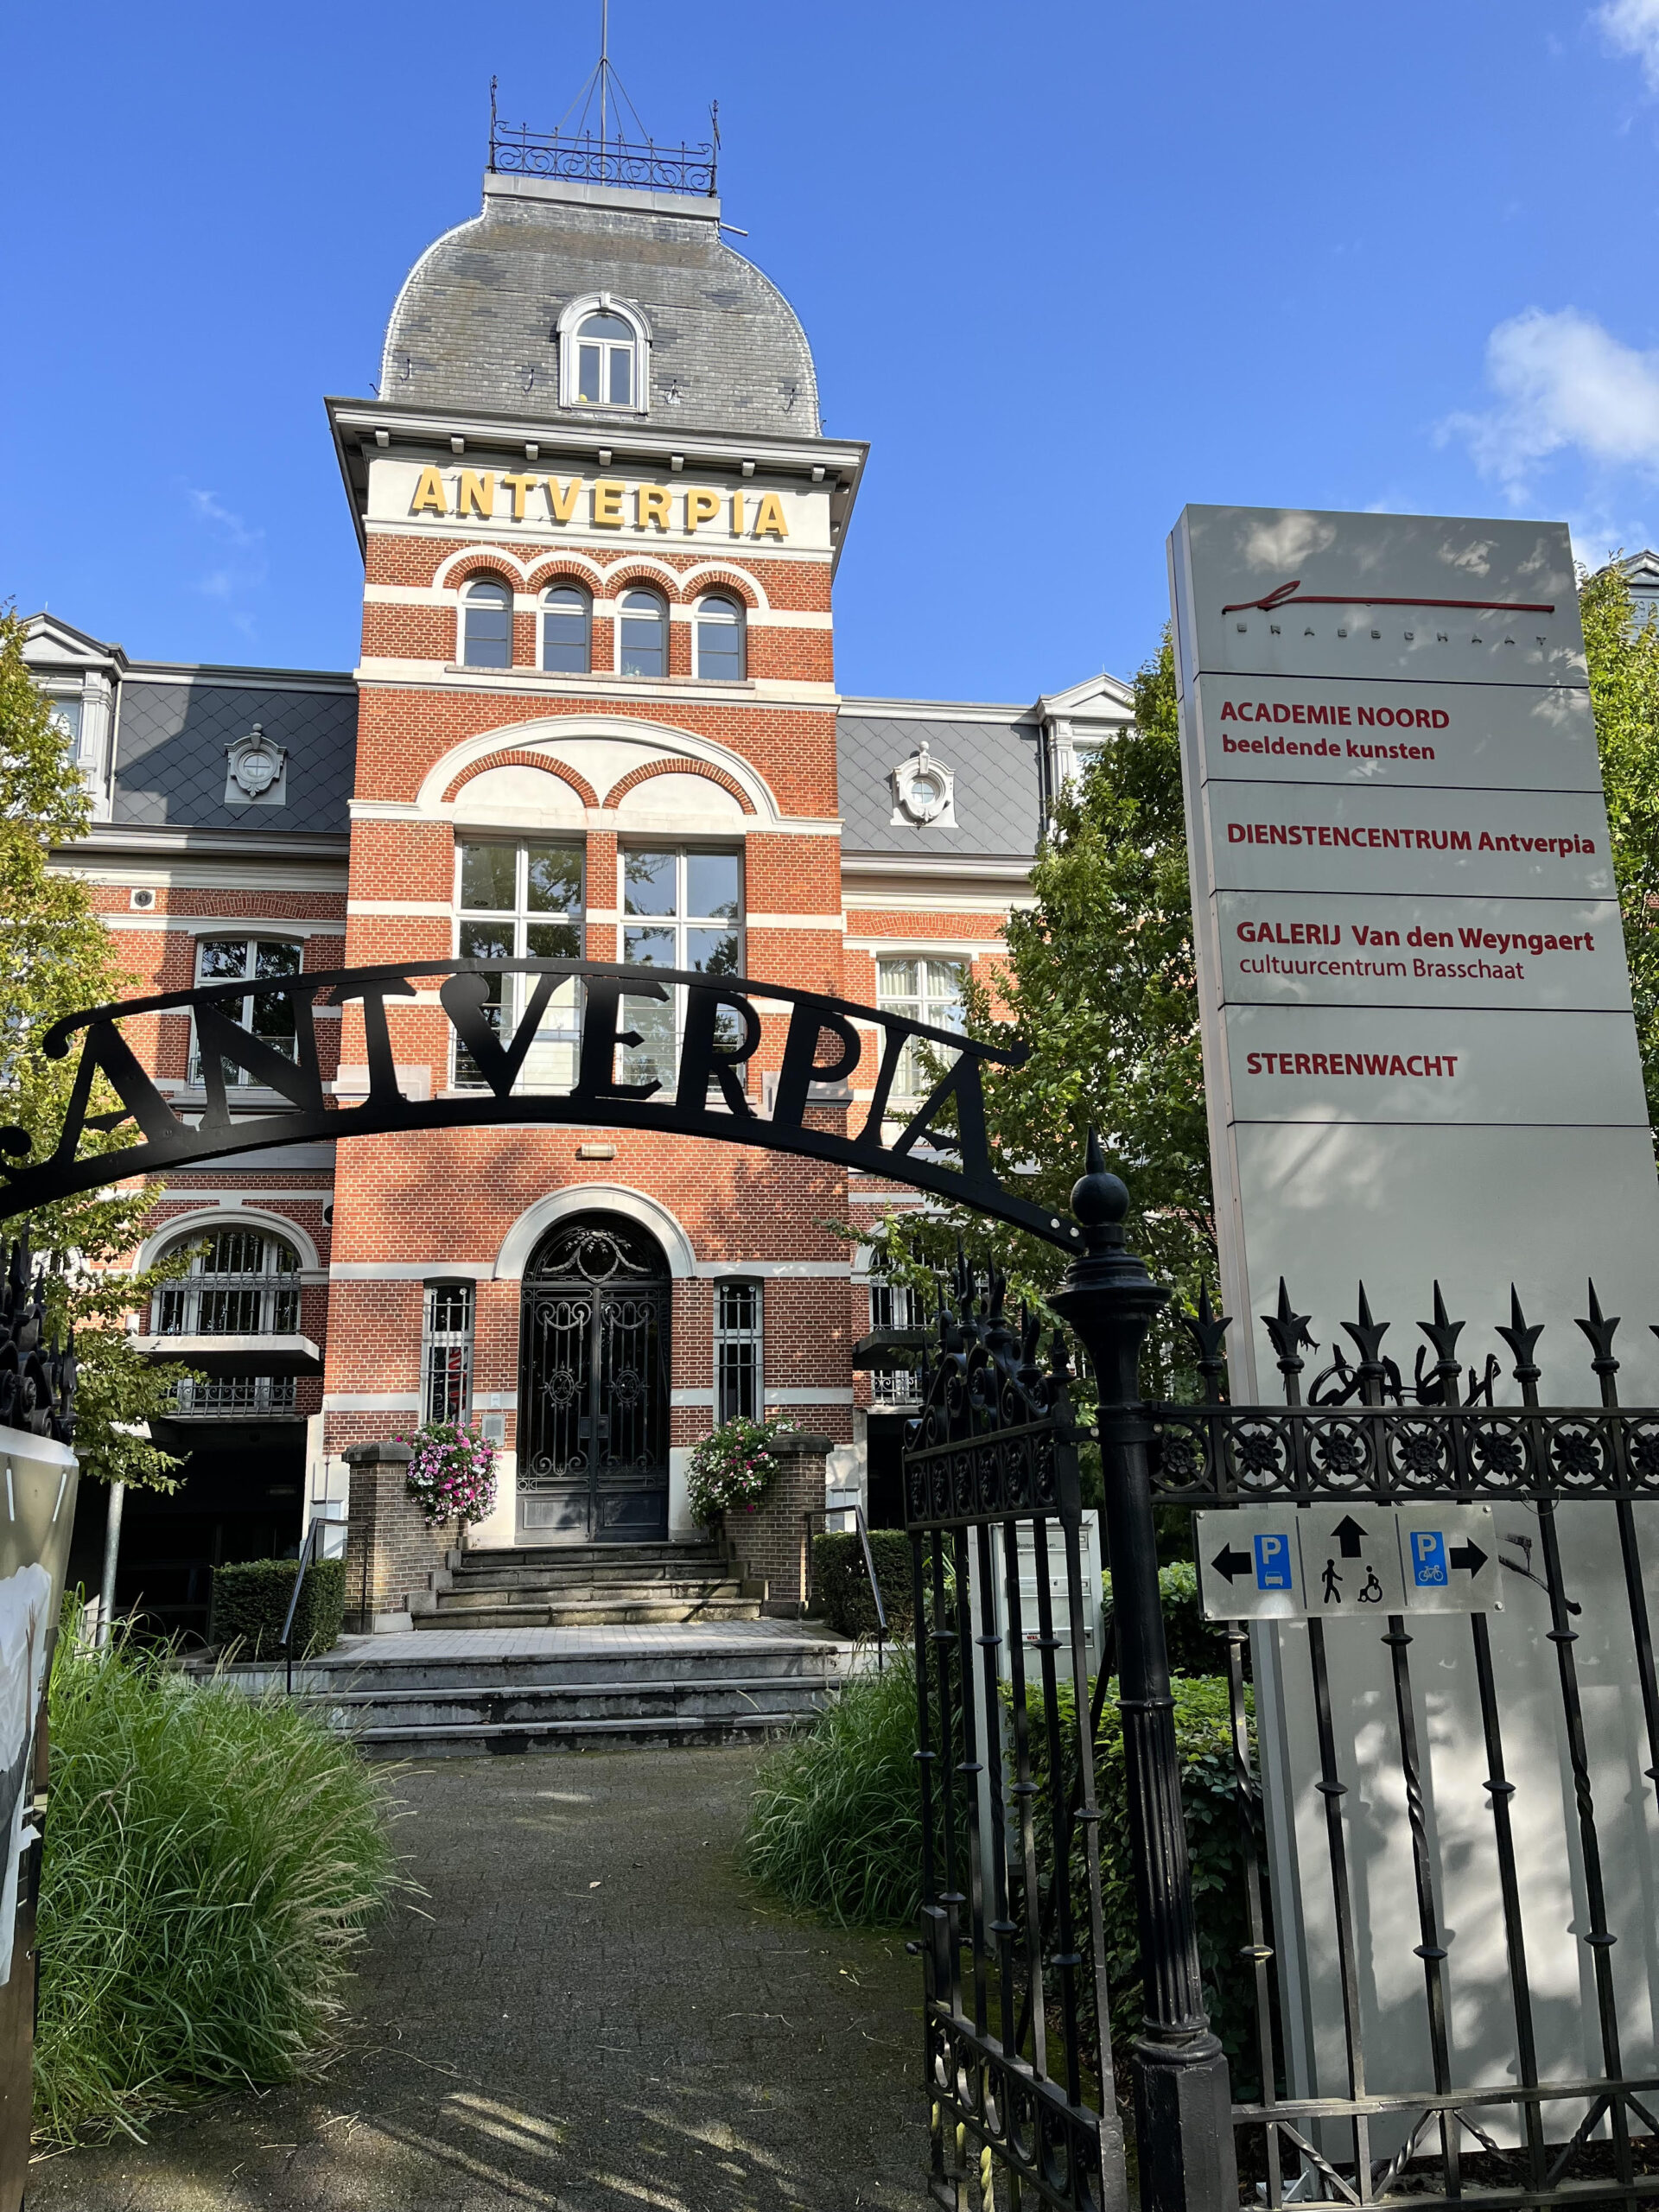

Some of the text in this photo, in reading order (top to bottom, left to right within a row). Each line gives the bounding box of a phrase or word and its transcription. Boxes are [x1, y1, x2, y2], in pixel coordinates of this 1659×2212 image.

[411, 467, 790, 537] ANTVERPIA
[1220, 701, 1451, 729] ACADEMIE NOORD
[1222, 734, 1435, 760] beeldende kunsten
[1227, 823, 1596, 858] DIENSTENCENTRUM Antverpia
[1236, 921, 1595, 956] GALERIJ Van den Weyngaert
[1239, 954, 1525, 981] cultuurcentrum Brasschaat
[54, 969, 1002, 1185] ANTVERPIA
[1246, 1052, 1459, 1077] STERRENWACHT
[1262, 1537, 1281, 1564] P
[1417, 1534, 1437, 1561] P
